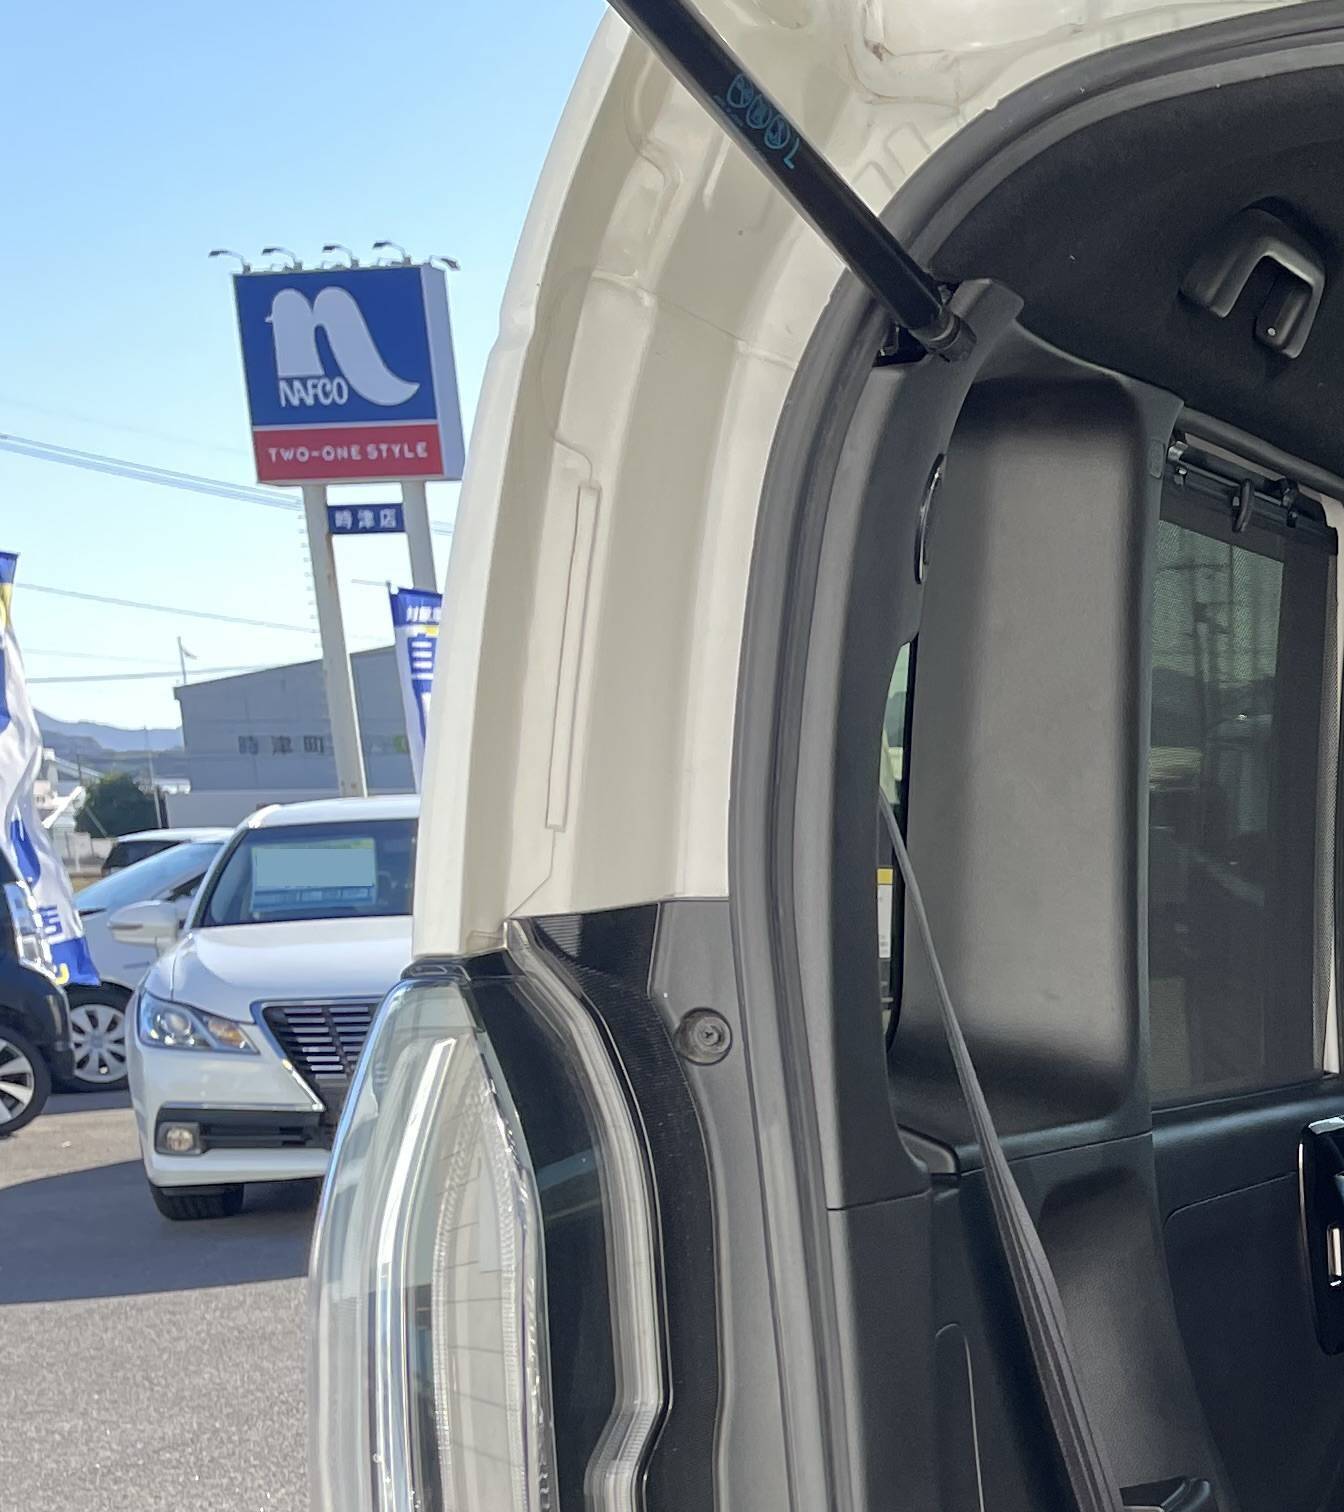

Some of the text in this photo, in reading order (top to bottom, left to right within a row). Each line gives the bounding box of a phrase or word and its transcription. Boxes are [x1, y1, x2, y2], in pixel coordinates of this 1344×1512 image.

[279, 376, 349, 407] NAFCO
[268, 441, 429, 463] TWO-ONE STYLE
